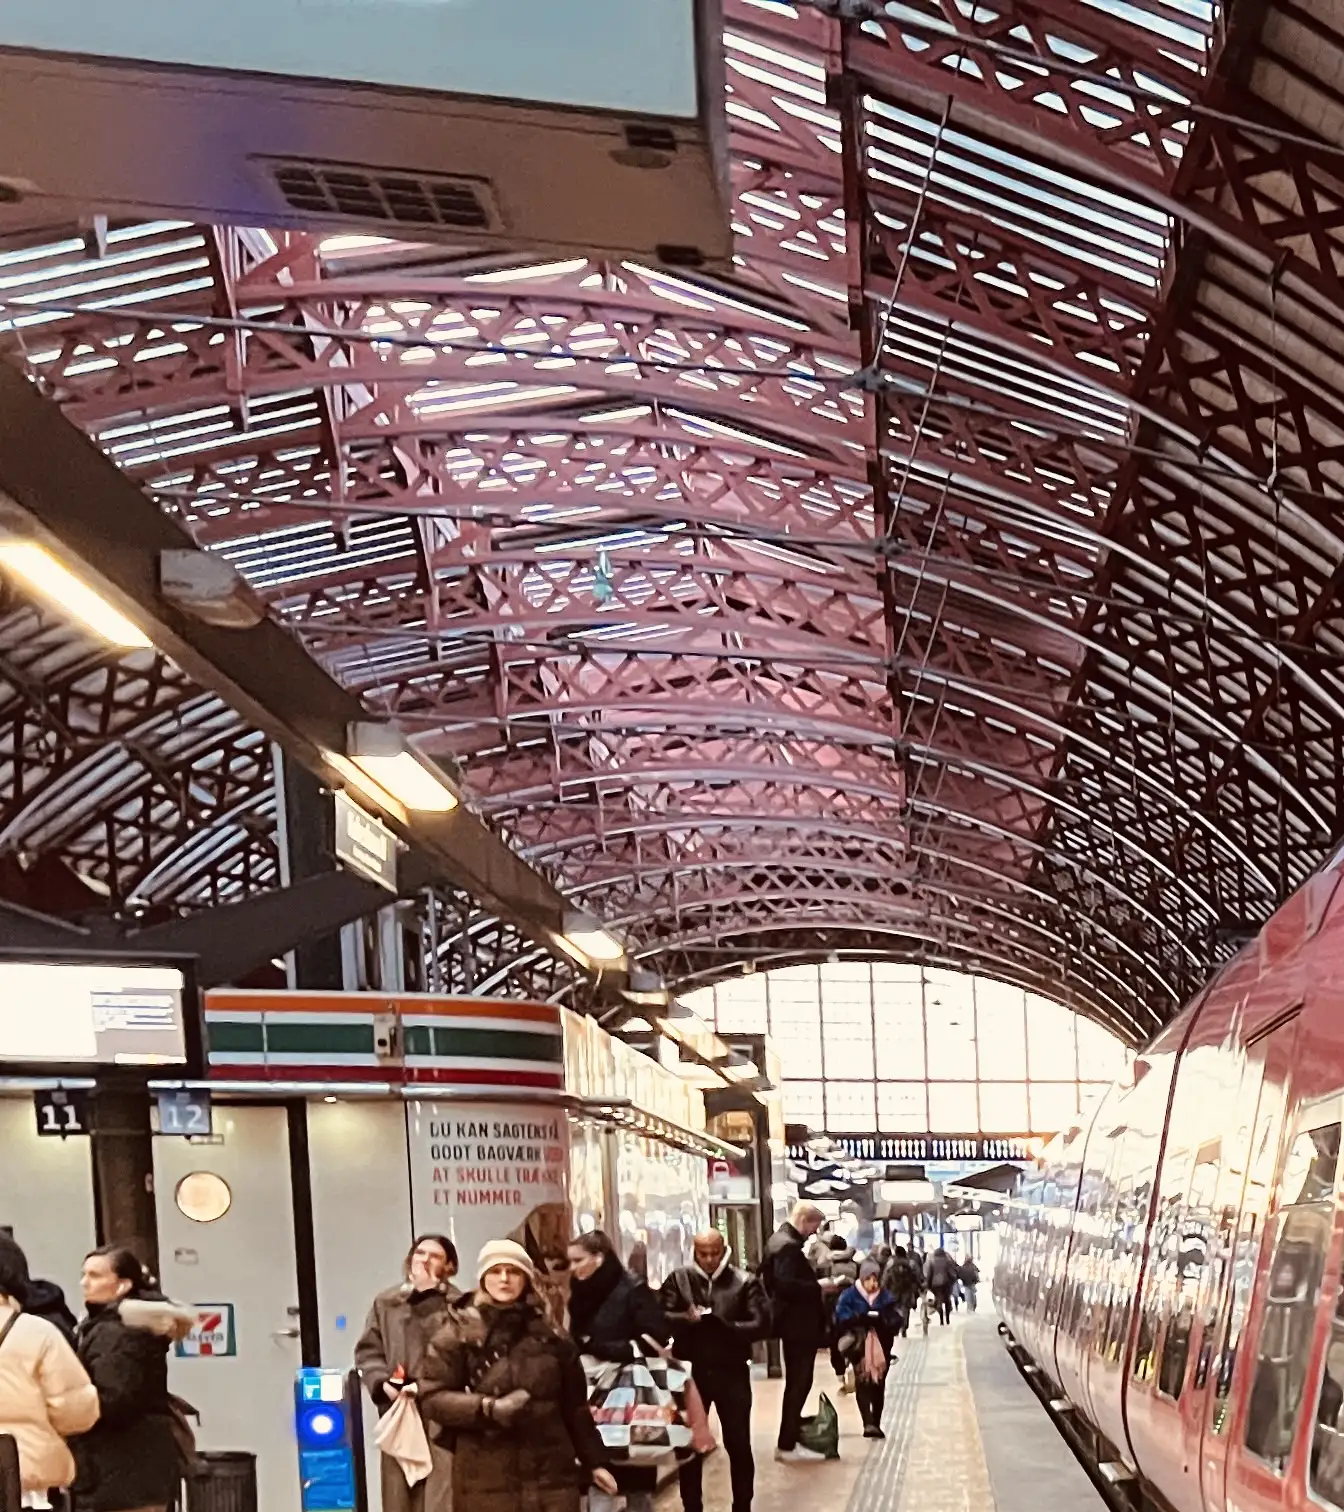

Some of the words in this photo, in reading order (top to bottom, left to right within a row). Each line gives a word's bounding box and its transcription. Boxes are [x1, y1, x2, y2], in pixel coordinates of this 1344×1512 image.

[42, 1105, 81, 1129] 11
[168, 1105, 207, 1129] 12
[430, 1122, 450, 1138] DU
[456, 1122, 488, 1138] KAN
[432, 1167, 449, 1181] AT
[456, 1168, 510, 1184] SKULLE
[433, 1190, 450, 1205] ET
